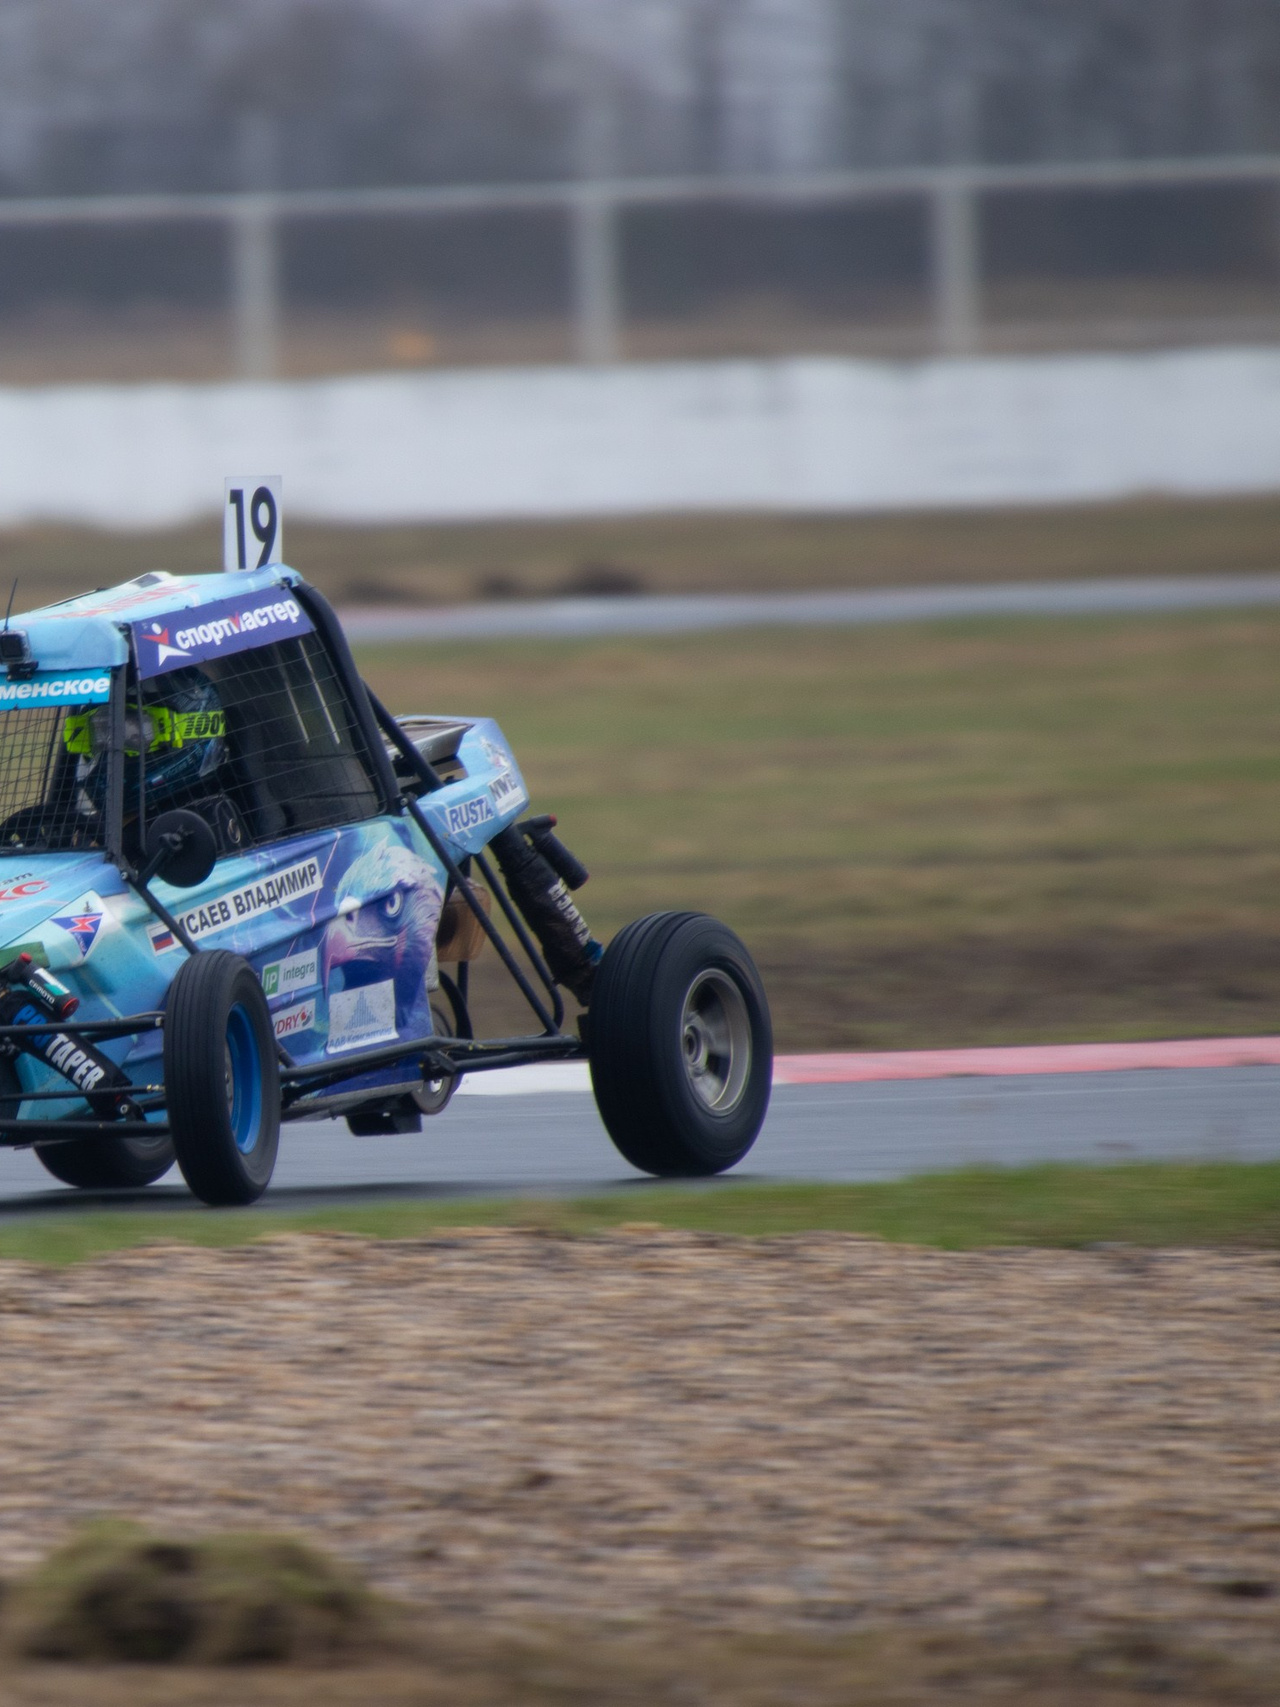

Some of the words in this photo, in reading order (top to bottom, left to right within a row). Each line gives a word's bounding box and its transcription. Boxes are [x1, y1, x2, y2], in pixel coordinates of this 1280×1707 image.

[229, 486, 277, 569] 19
[175, 599, 301, 650] спортмастер
[449, 798, 493, 833] RUSTA
[233, 863, 318, 915] ВЛАДИМИР
[265, 971, 278, 992] IP
[283, 961, 315, 982] integra
